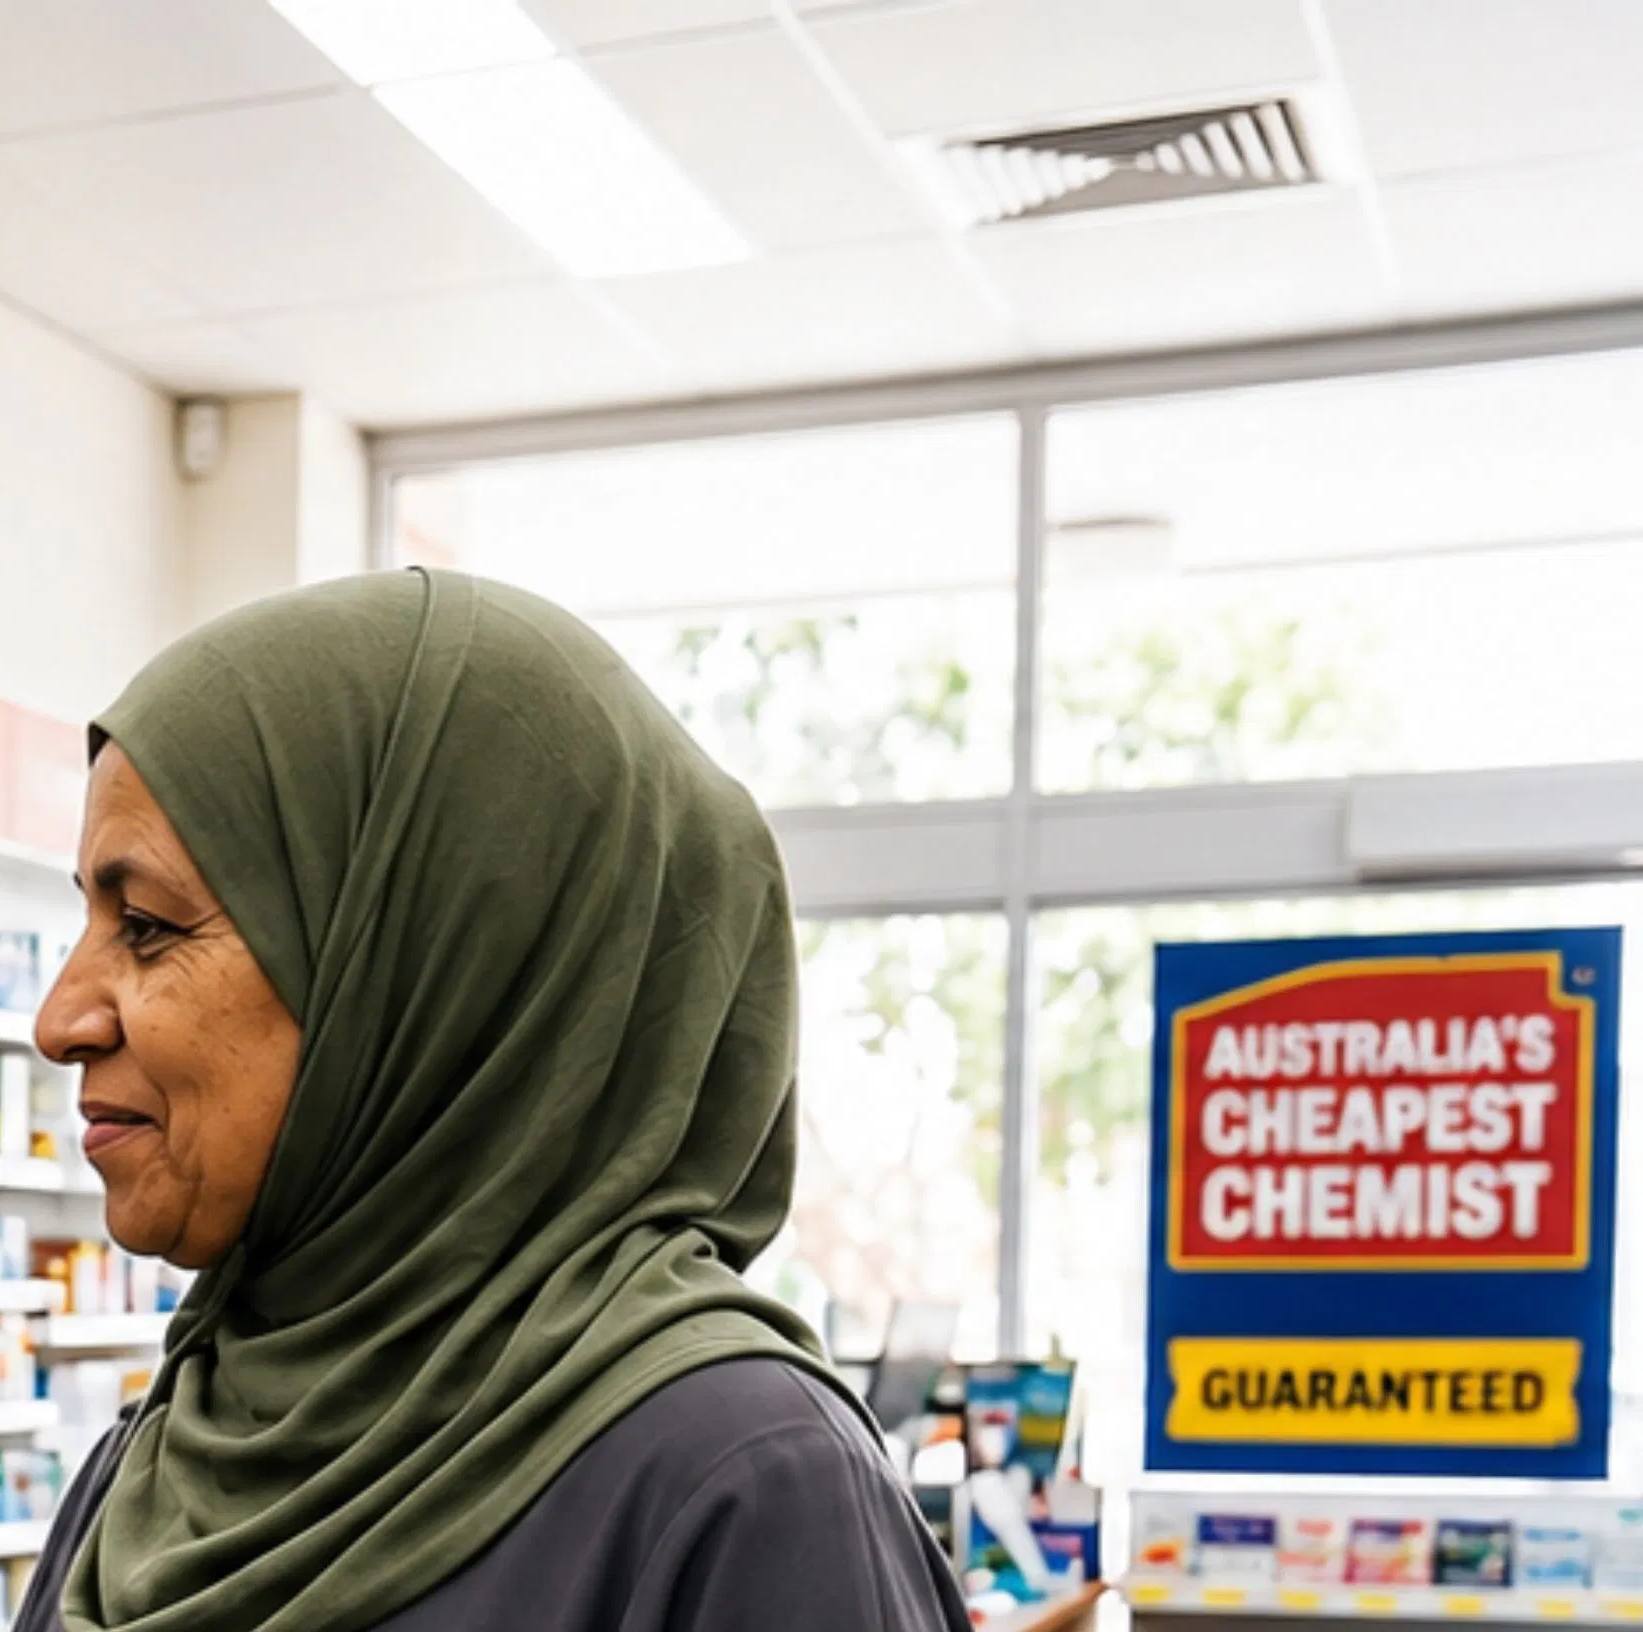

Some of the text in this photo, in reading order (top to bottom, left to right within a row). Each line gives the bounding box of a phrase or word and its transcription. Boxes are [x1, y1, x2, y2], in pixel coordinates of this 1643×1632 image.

[1202, 1014, 1555, 1080] AUSTRALIA'S
[1201, 1083, 1557, 1155] CHEAPEST
[1200, 1162, 1552, 1240] CHEMIST
[1199, 1367, 1547, 1413] GUARANTEED
